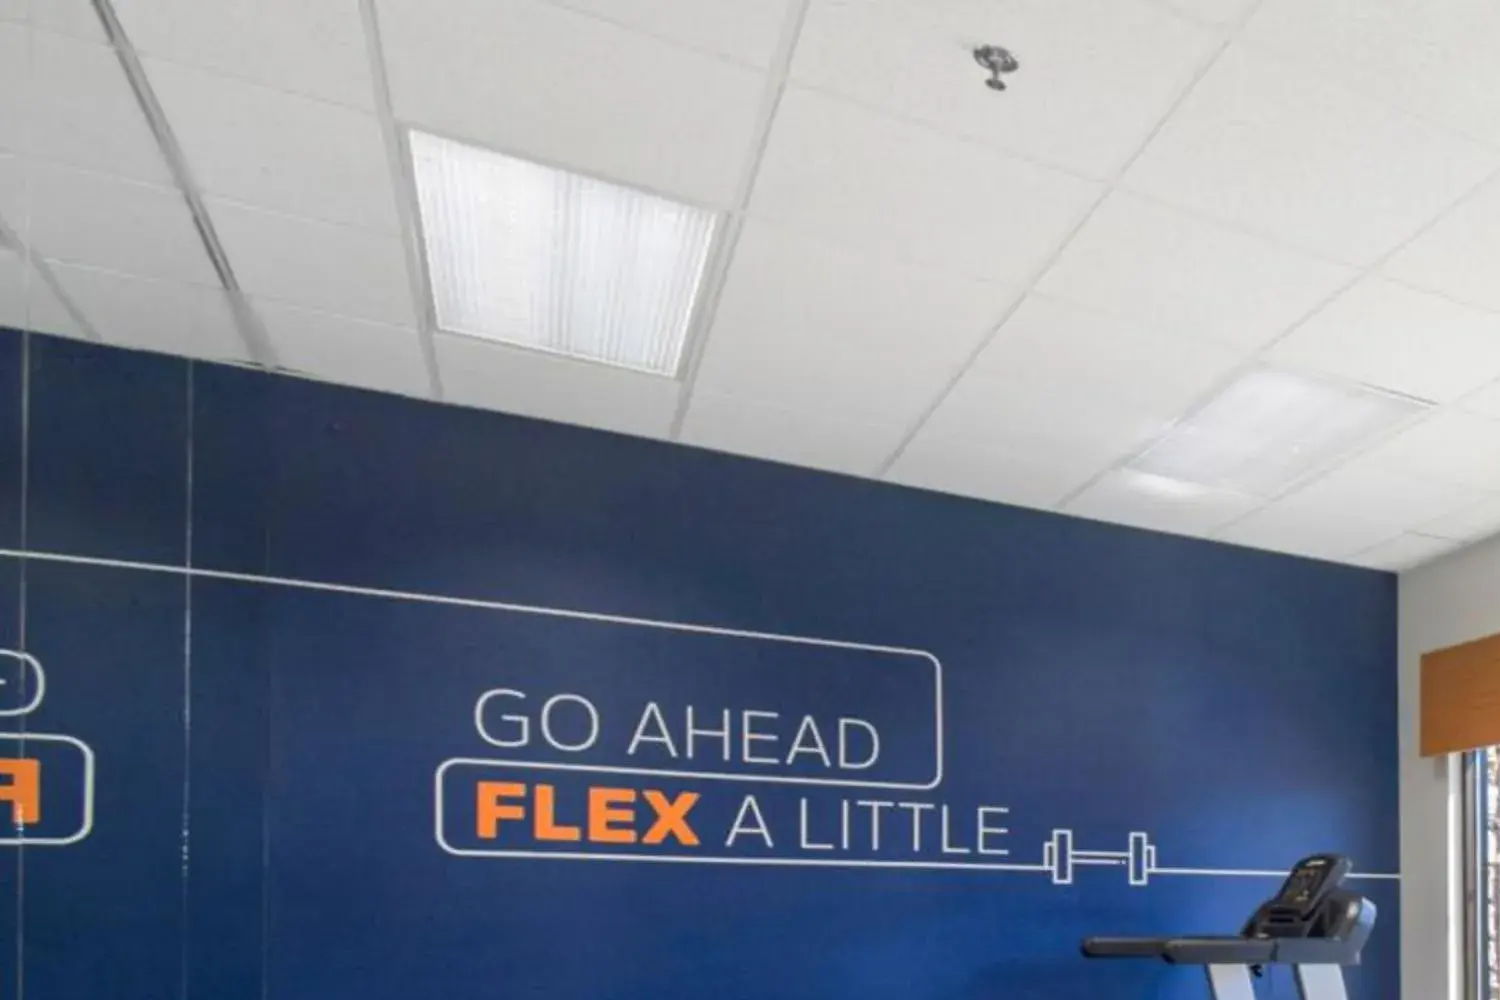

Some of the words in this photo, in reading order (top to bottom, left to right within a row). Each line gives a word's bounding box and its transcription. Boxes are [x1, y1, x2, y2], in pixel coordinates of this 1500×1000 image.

[473, 687, 600, 752] GO
[627, 701, 880, 770] AHEAD
[475, 780, 701, 847] FLEX
[725, 794, 774, 848] A
[800, 797, 1009, 855] LITTLE
